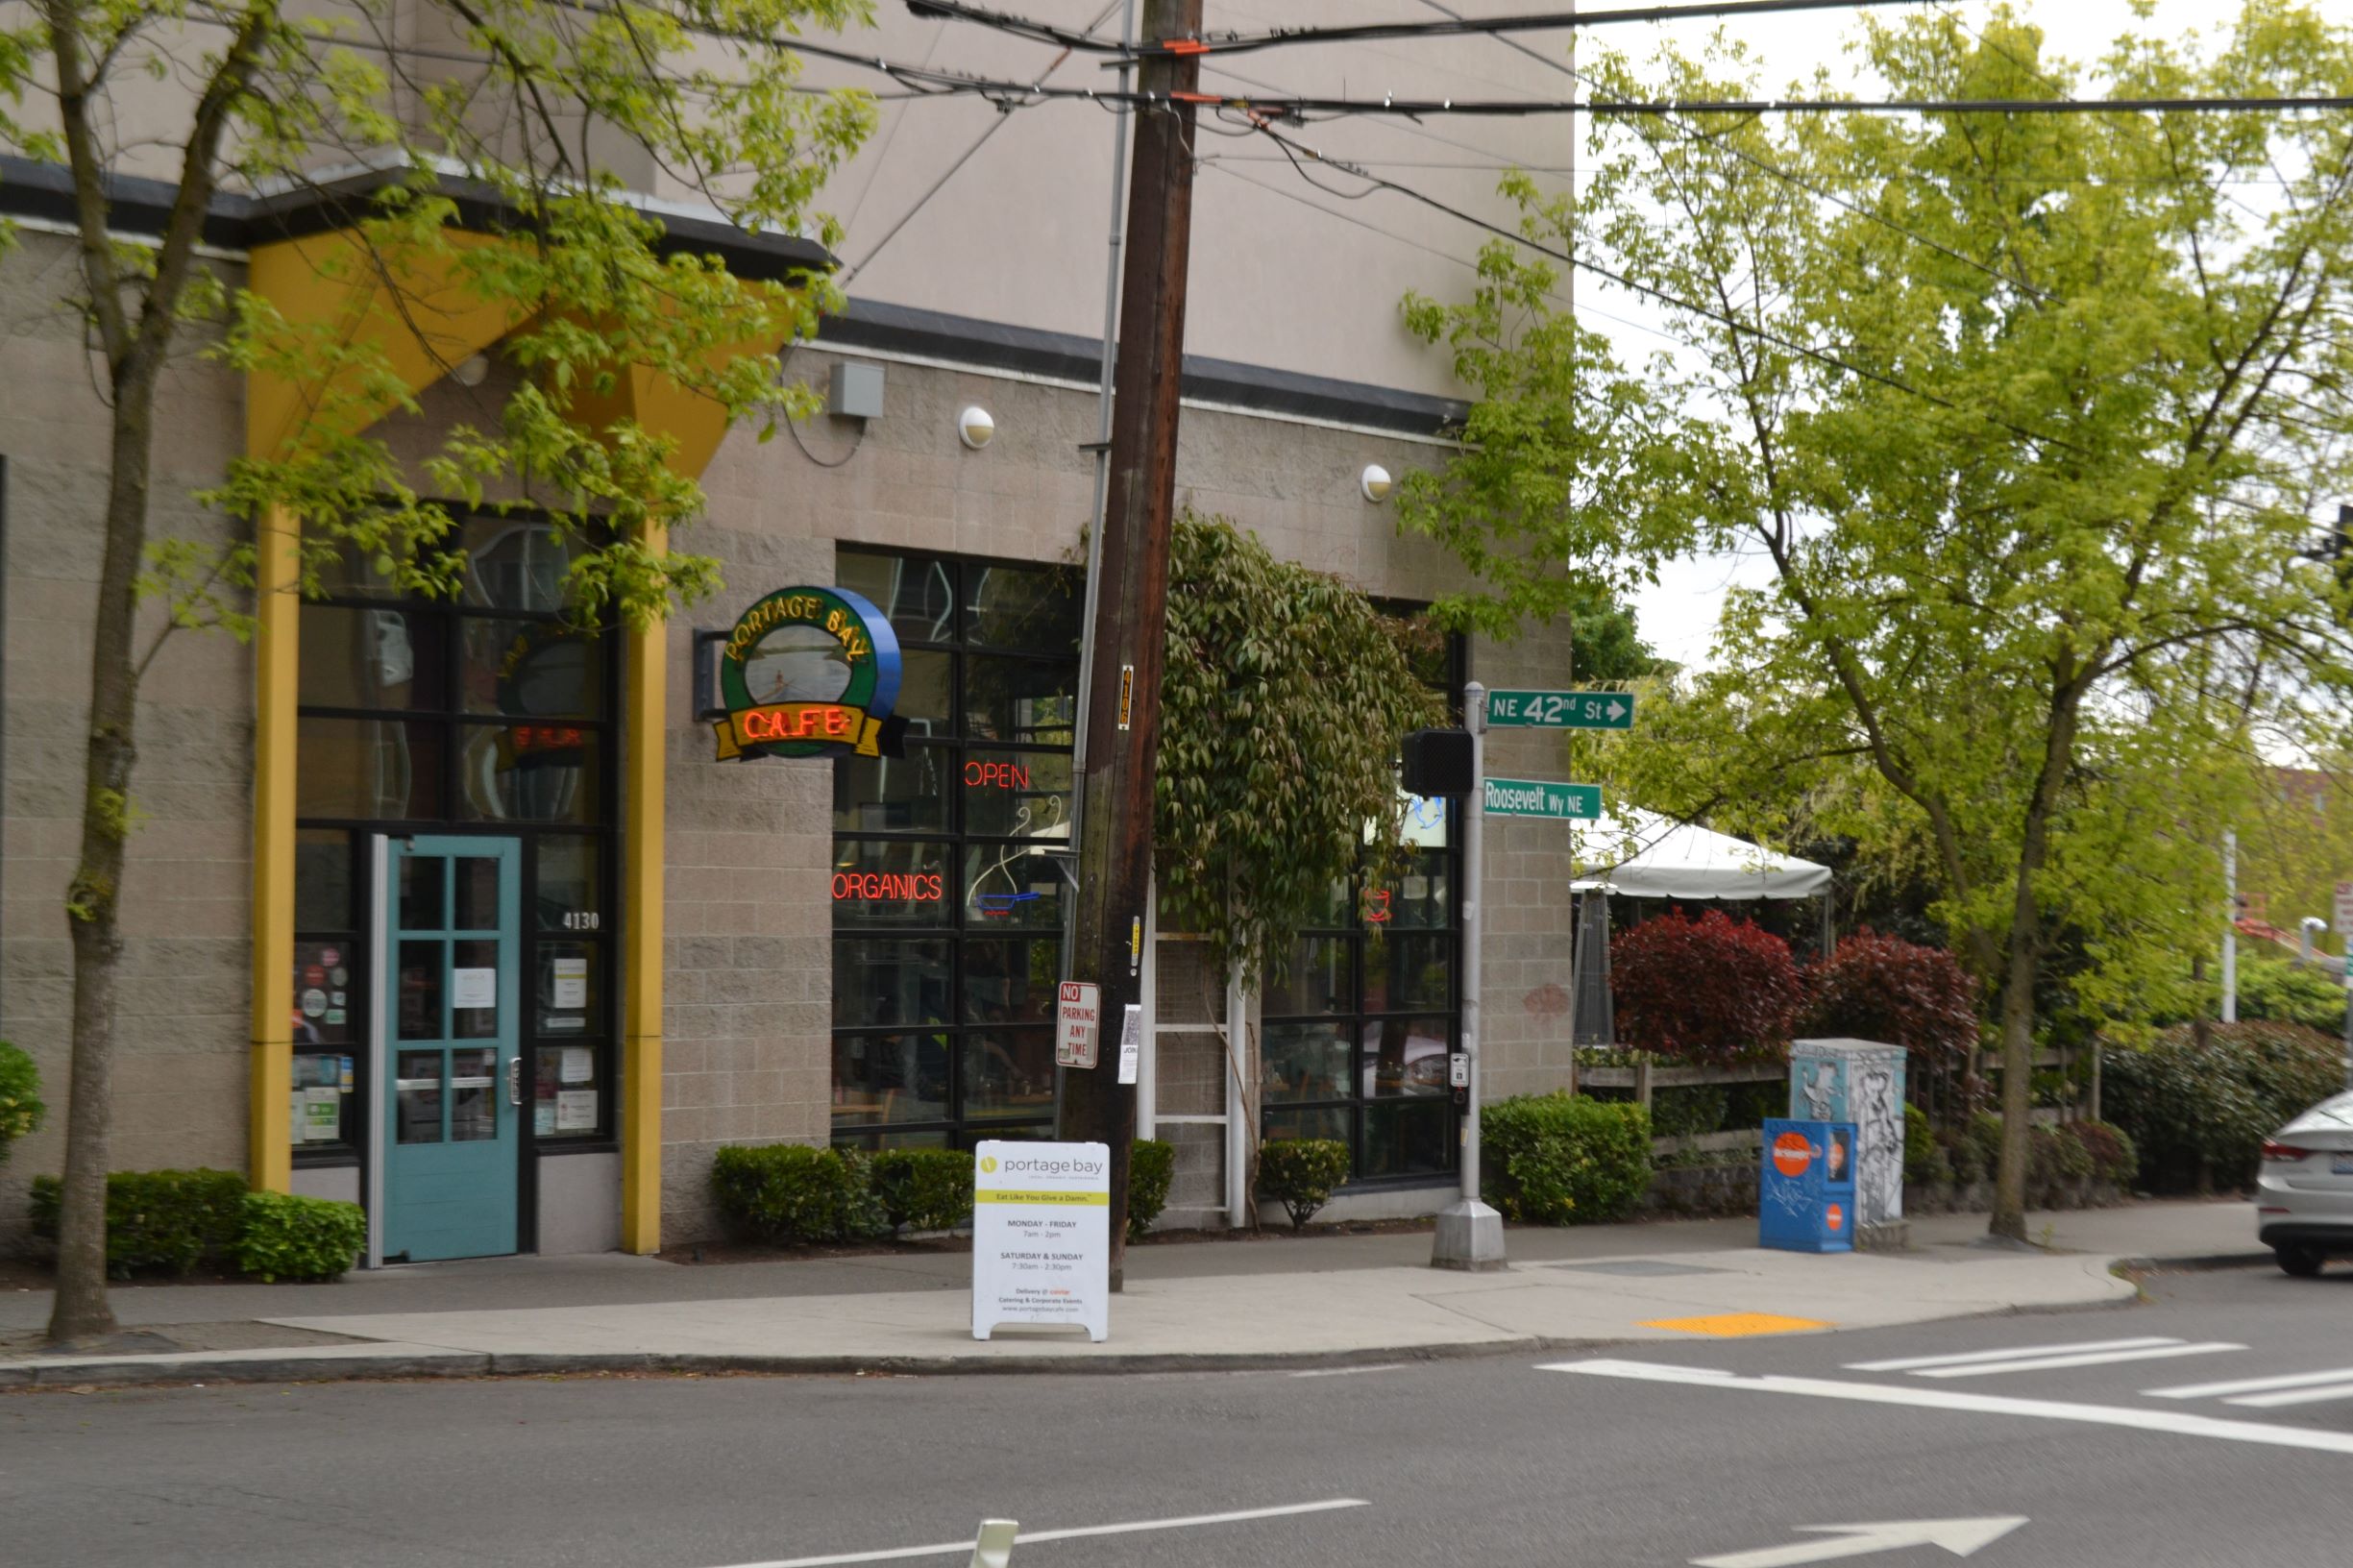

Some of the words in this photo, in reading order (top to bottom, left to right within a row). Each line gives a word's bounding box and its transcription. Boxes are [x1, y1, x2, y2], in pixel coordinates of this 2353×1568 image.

[724, 596, 820, 661] PORTAGE
[826, 609, 870, 662] BAY
[1121, 671, 1132, 723] 4106
[1494, 698, 1518, 718] NE
[1523, 696, 1576, 723] 42nd
[1584, 701, 1603, 720] St
[744, 708, 842, 739] CAFE
[965, 762, 1029, 789] OPEN
[1485, 781, 1545, 811] Roosevelt
[1549, 794, 1564, 816] Wy
[1567, 796, 1583, 813] NE
[831, 873, 942, 900] ORGANICS
[563, 912, 600, 929] 4130
[1063, 986, 1079, 1000] NO
[1062, 1007, 1094, 1021] PARKING
[1069, 1025, 1086, 1038] ANY
[1068, 1042, 1087, 1056] TIME
[1005, 1158, 1070, 1174] portage
[1073, 1159, 1103, 1174] bay
[1044, 1231, 1061, 1239] 2pm
